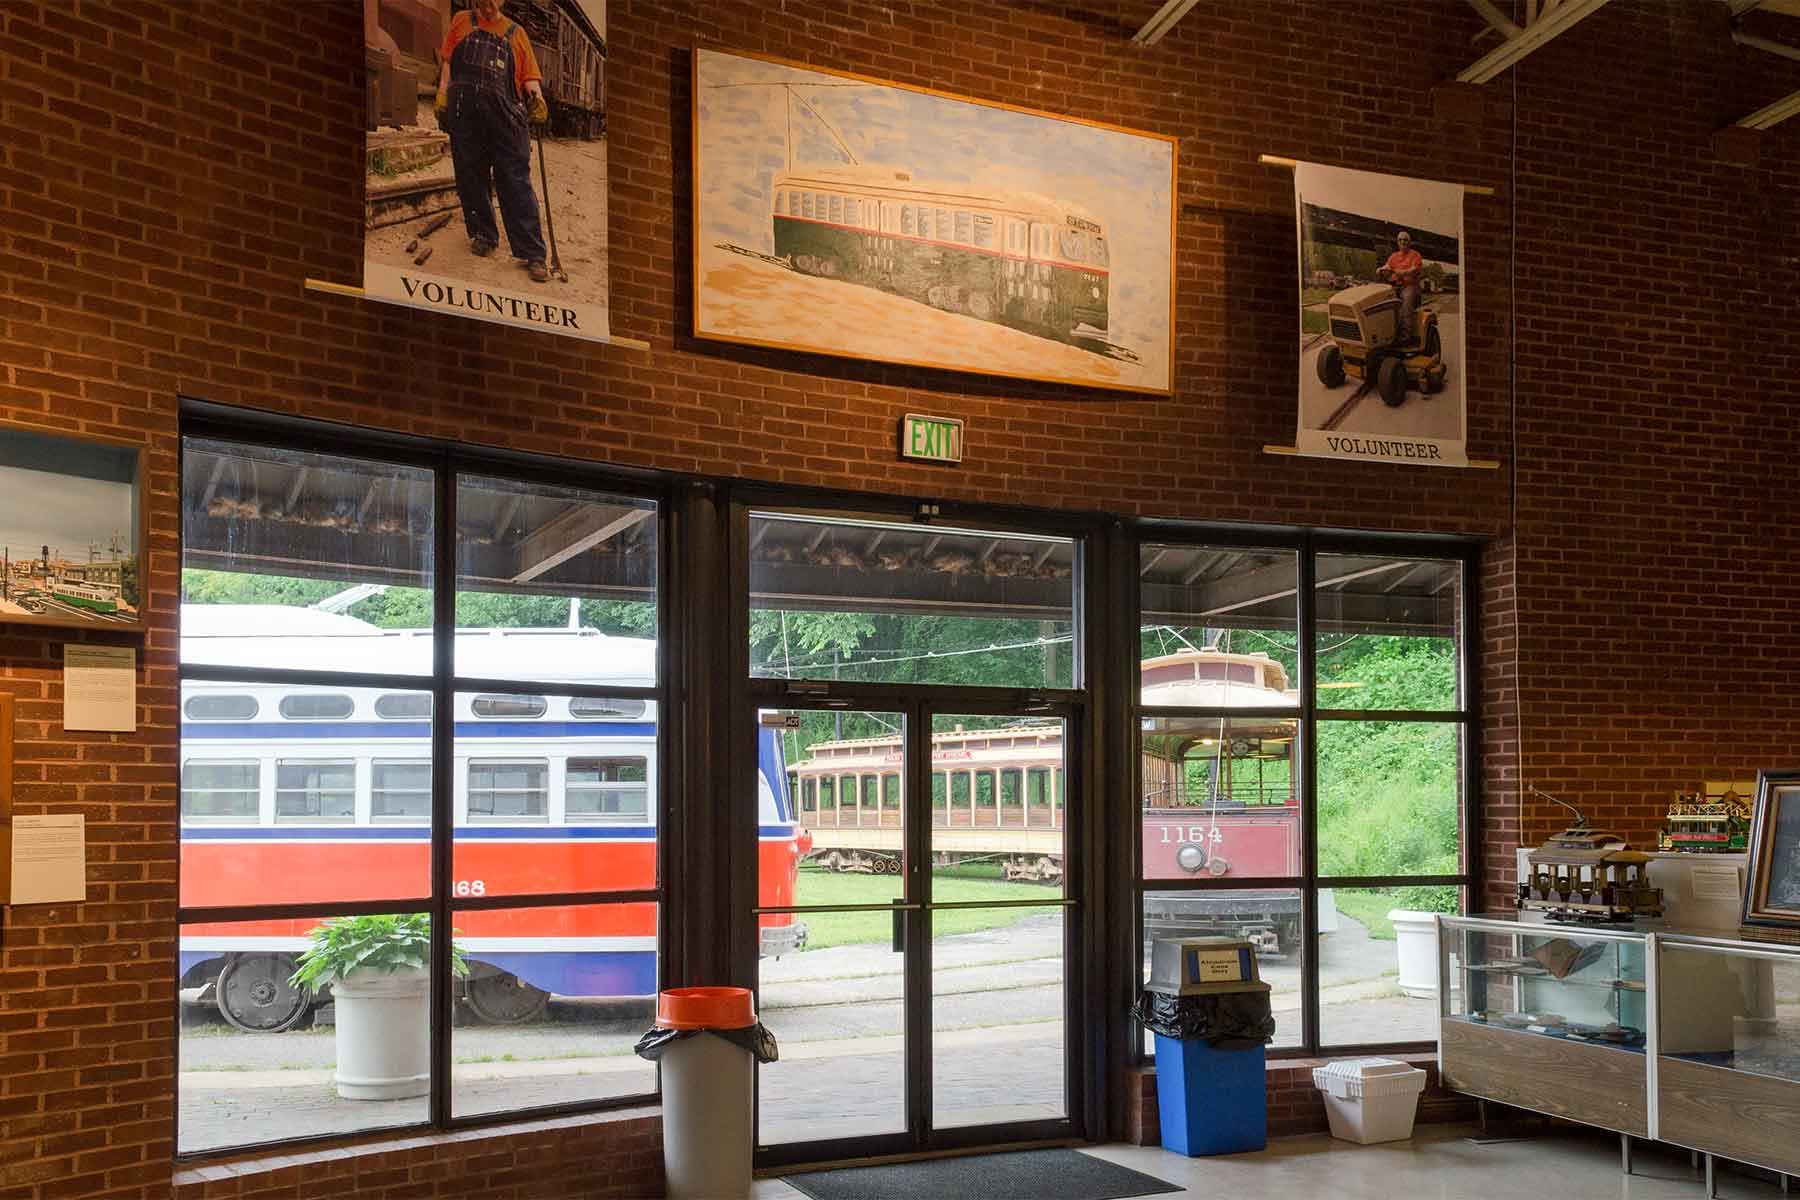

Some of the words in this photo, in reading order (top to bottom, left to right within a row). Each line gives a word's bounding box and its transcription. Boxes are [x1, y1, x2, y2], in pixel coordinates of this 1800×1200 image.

[400, 277, 581, 329] VOLUNTEER
[912, 419, 954, 457] EXIT
[1326, 437, 1441, 459] VOLUNTEER
[1160, 826, 1223, 844] 1164
[453, 880, 486, 897] 68
